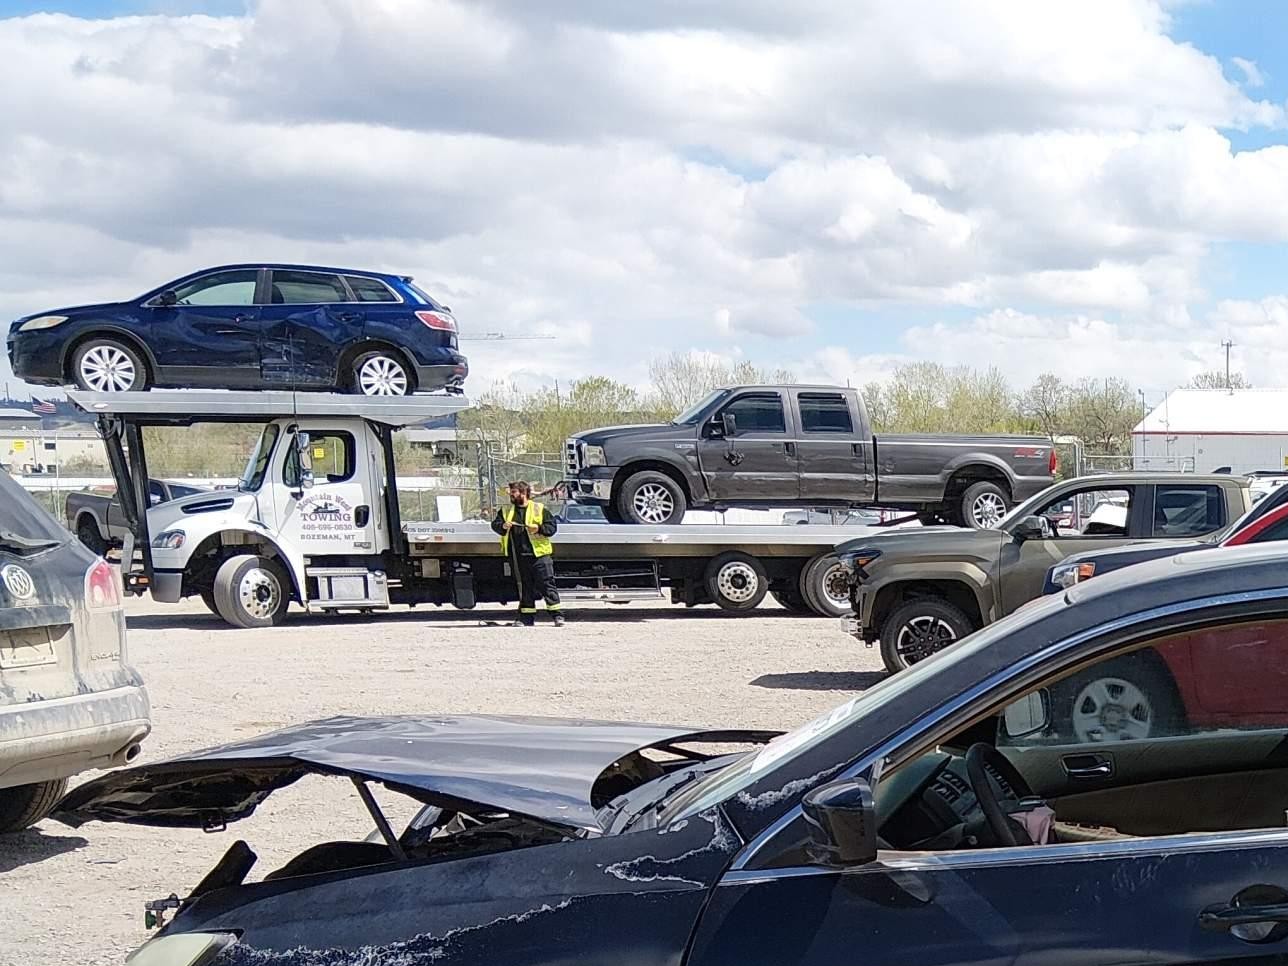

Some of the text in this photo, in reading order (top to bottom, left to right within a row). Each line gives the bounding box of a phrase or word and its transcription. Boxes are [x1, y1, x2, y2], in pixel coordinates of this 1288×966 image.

[296, 492, 352, 511] Mountain West
[300, 513, 352, 522] TOWING
[301, 533, 342, 541] BOZEMAN,
